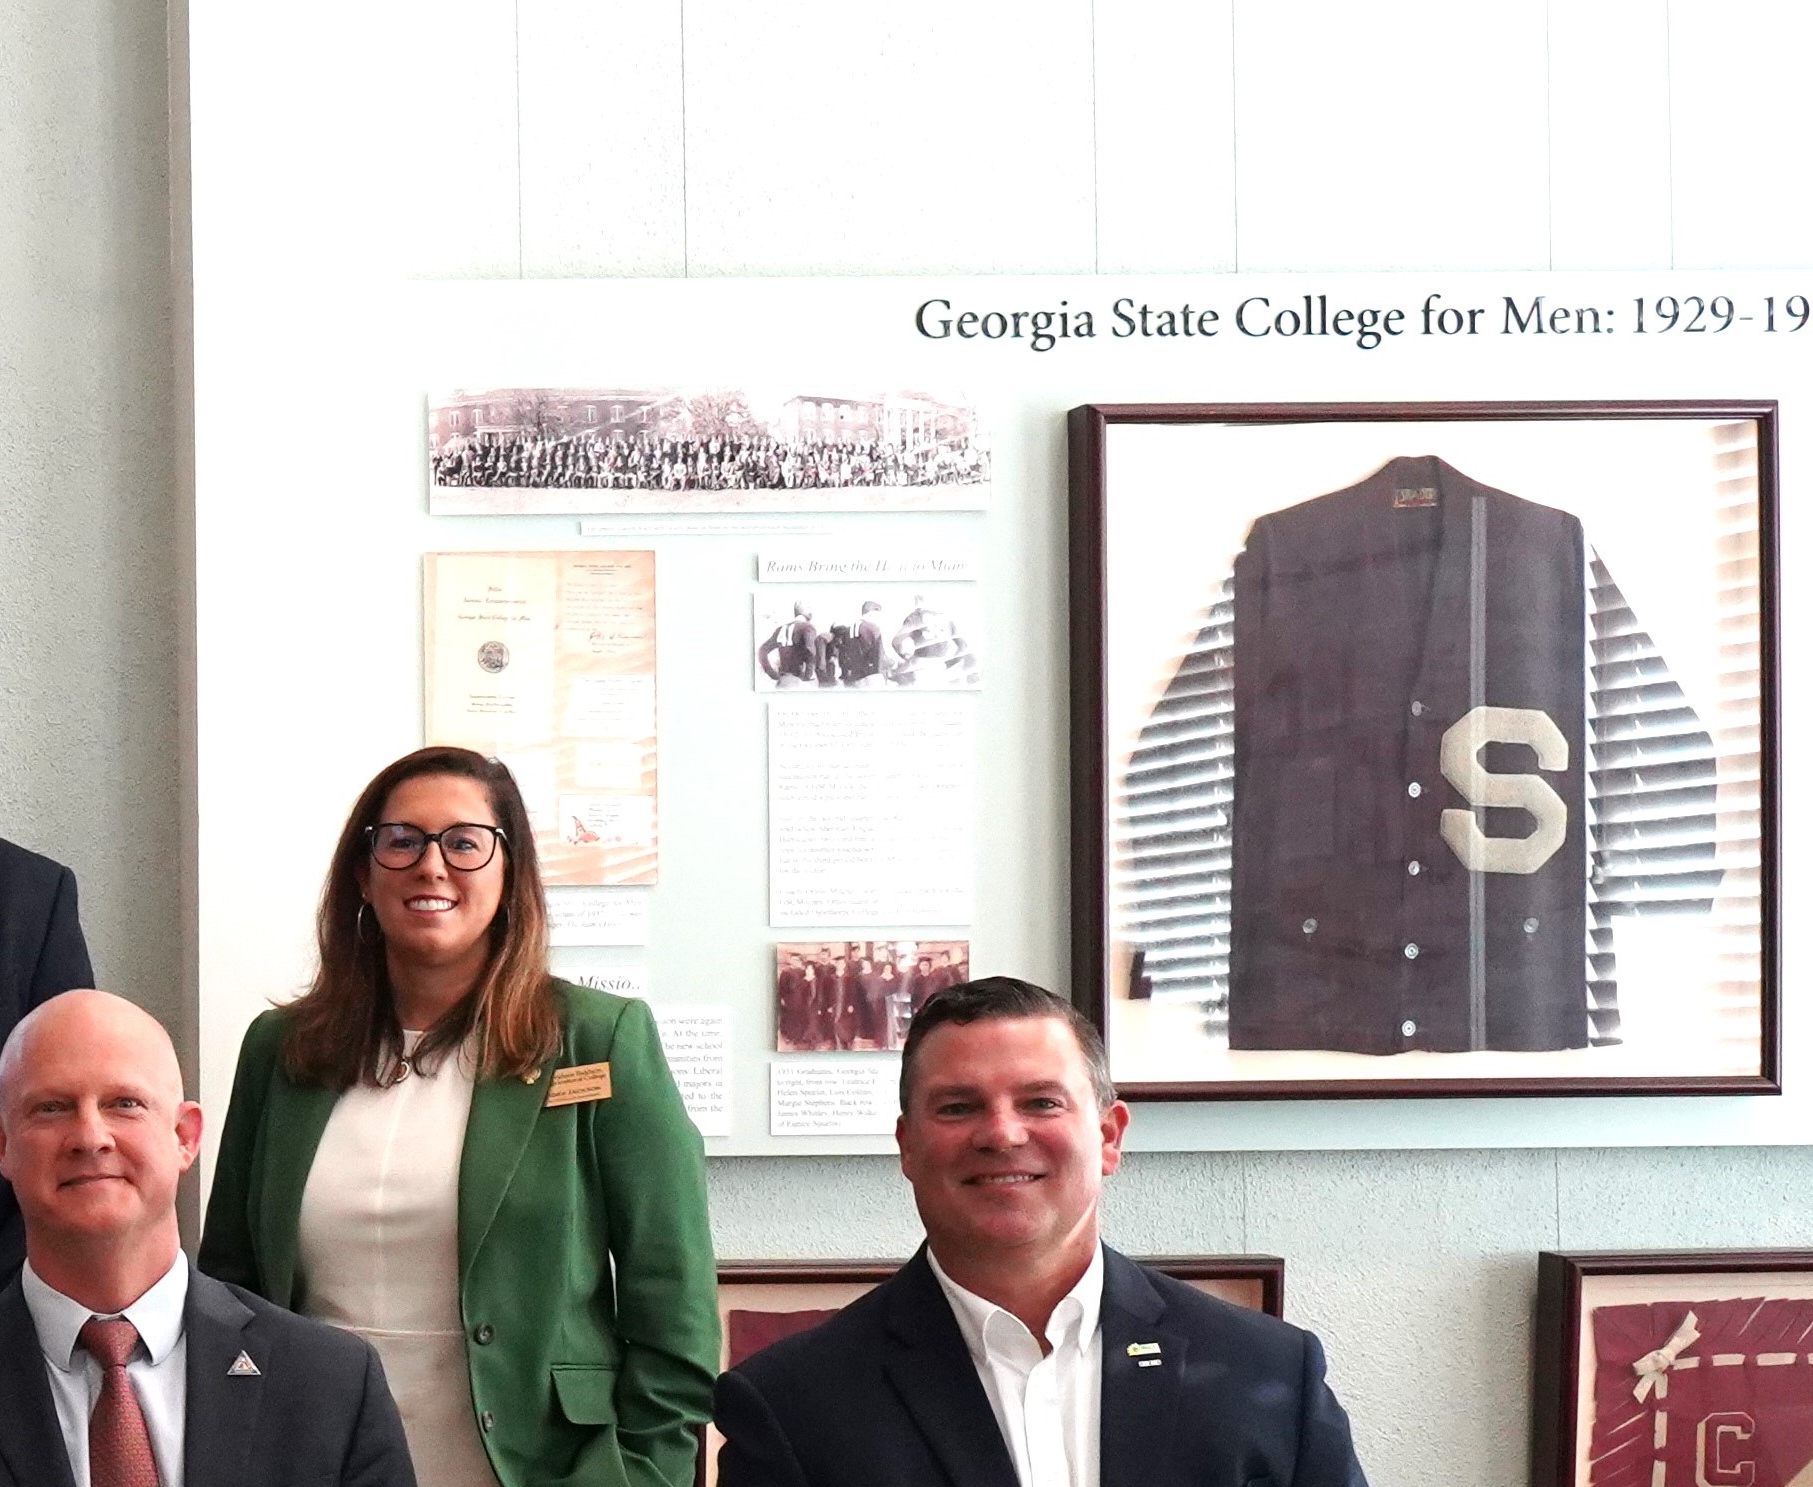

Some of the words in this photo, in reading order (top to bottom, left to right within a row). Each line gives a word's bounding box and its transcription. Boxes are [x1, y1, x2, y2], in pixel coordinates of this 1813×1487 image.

[914, 296, 1095, 352] Georgia
[1111, 296, 1220, 338] State
[1236, 295, 1404, 350] College
[1420, 295, 1486, 336] for
[1502, 296, 1615, 335] Men:
[766, 560, 803, 573] Rams
[808, 560, 847, 575] Bring
[850, 560, 869, 573] the
[1440, 706, 1569, 874] S
